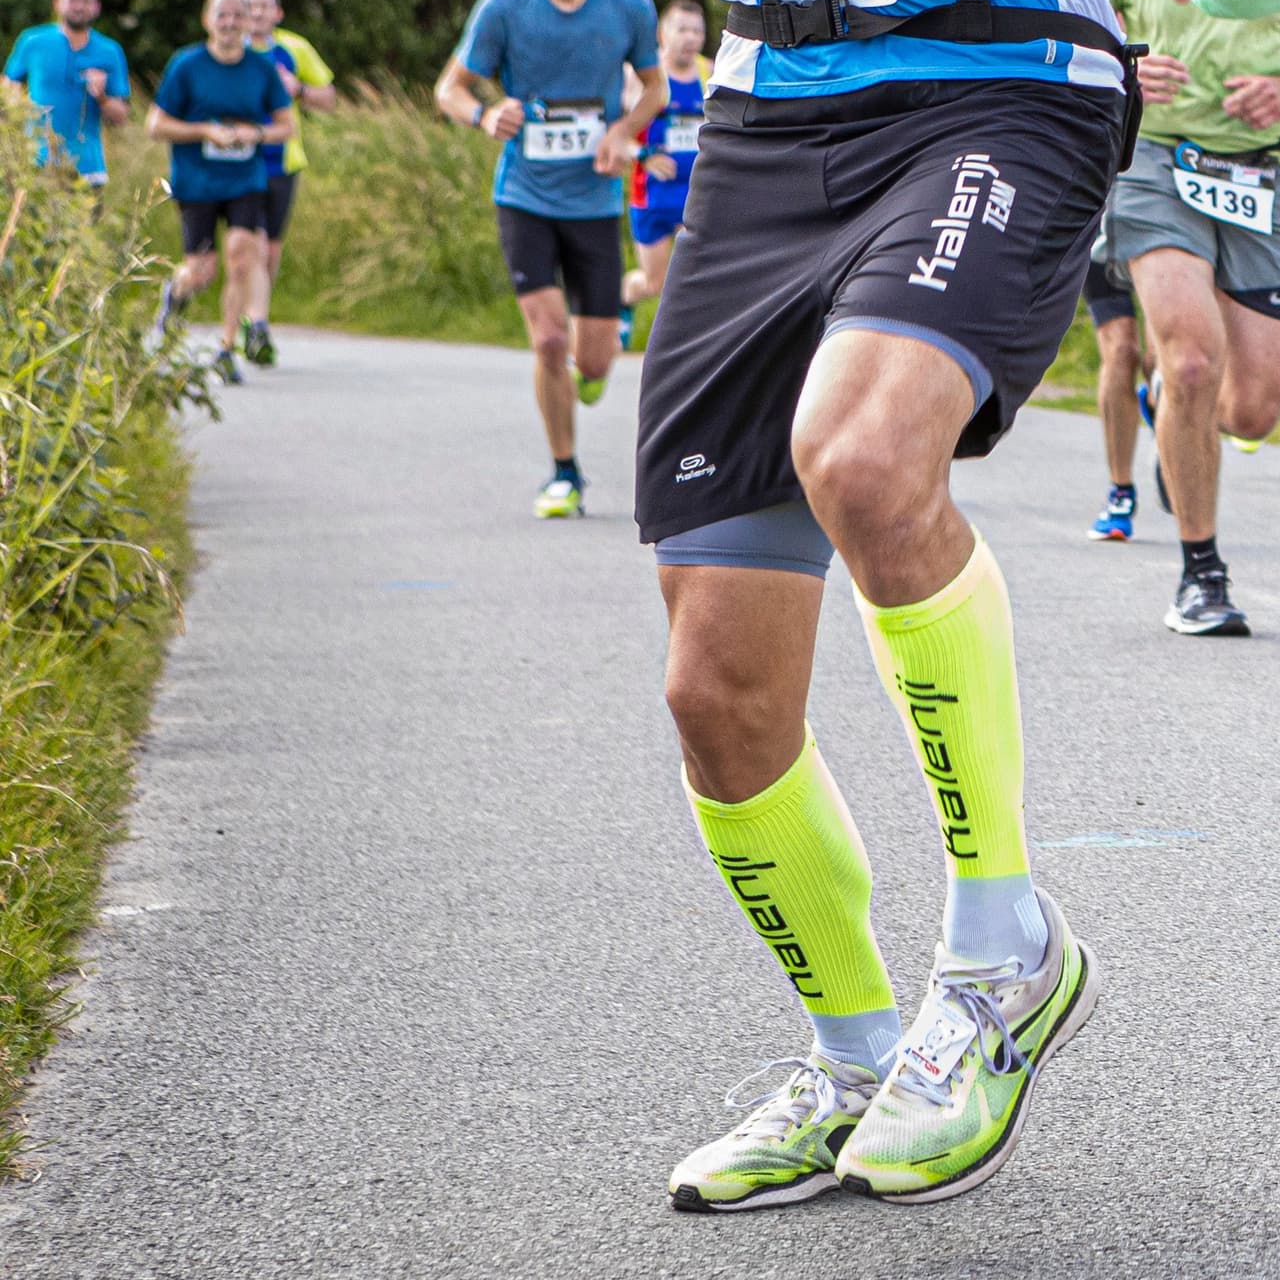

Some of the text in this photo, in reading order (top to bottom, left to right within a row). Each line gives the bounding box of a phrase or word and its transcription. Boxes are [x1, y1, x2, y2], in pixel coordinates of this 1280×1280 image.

[543, 129, 590, 152] 757
[907, 153, 1000, 293] Kalenji
[981, 178, 1017, 234] TEAM
[1186, 180, 1258, 219] 2139
